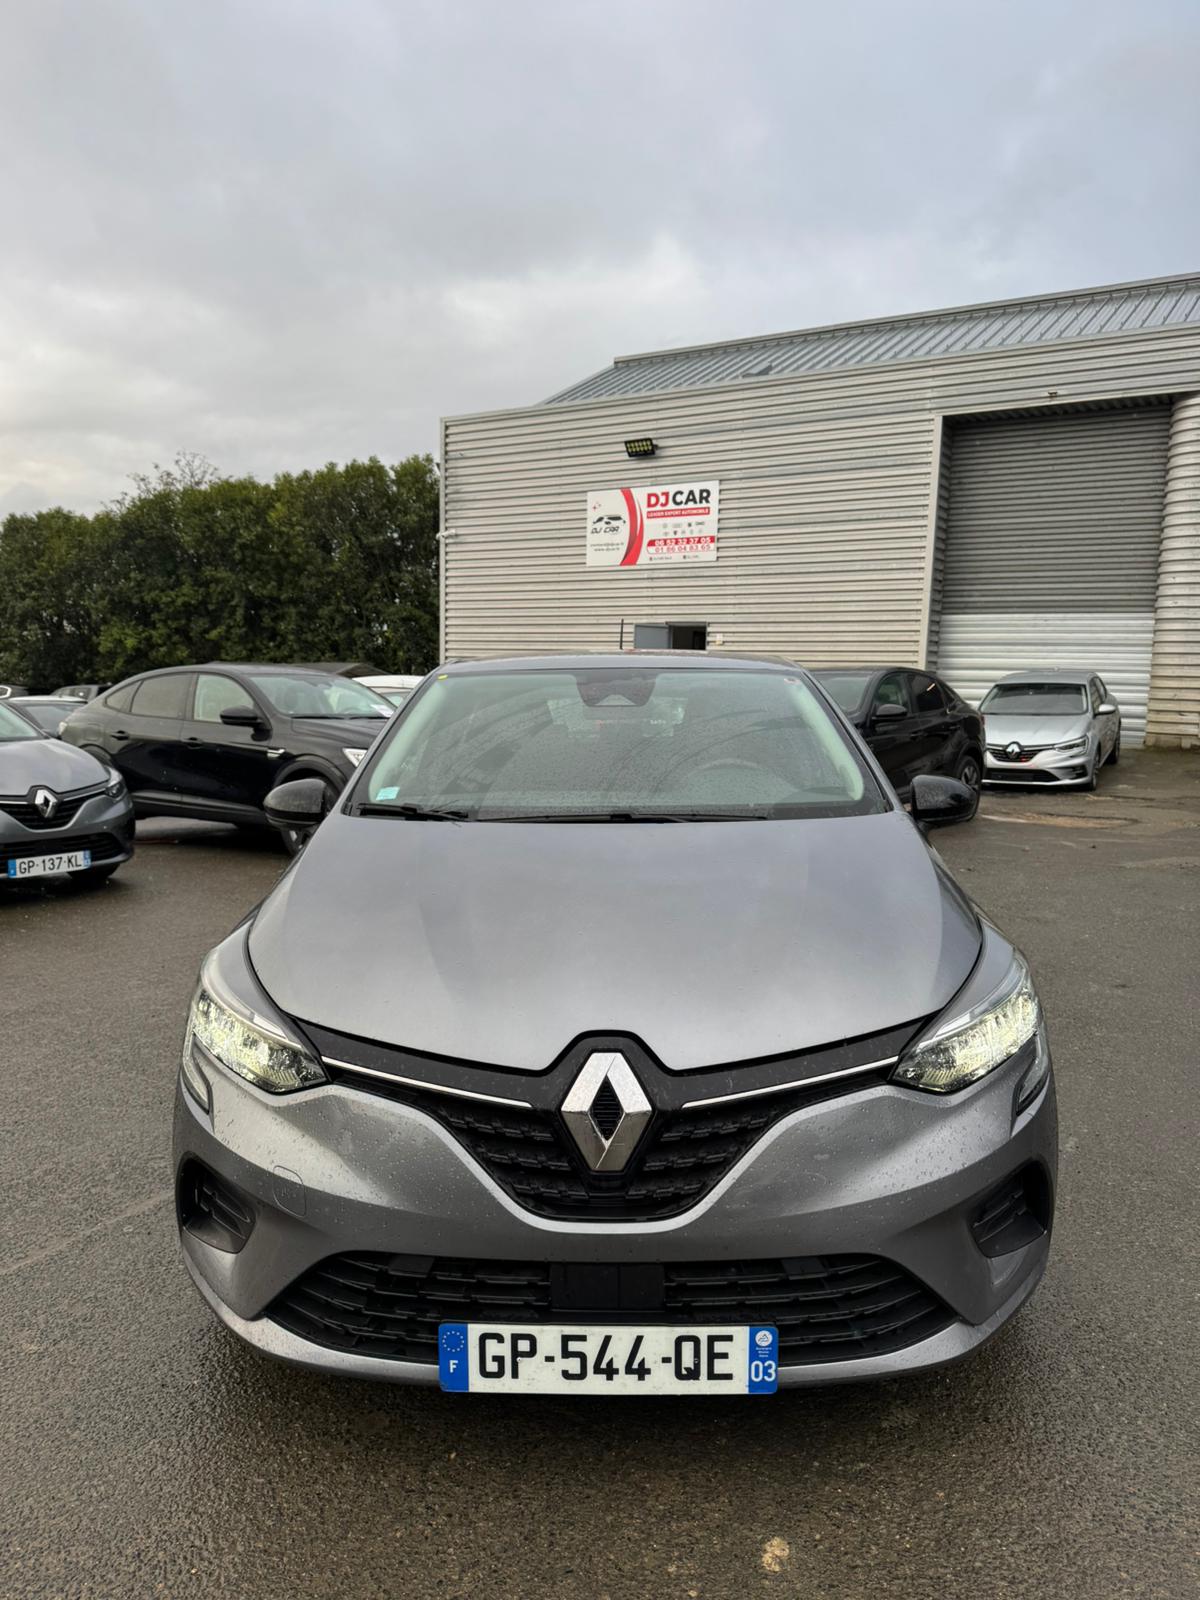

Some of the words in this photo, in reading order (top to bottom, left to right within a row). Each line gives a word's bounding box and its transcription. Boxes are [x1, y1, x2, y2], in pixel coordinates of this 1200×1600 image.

[647, 492, 670, 508] DJ
[672, 489, 711, 505] CAR
[449, 1360, 458, 1373] F
[478, 1332, 734, 1381] GP-544-QE
[751, 1360, 776, 1382] 03
